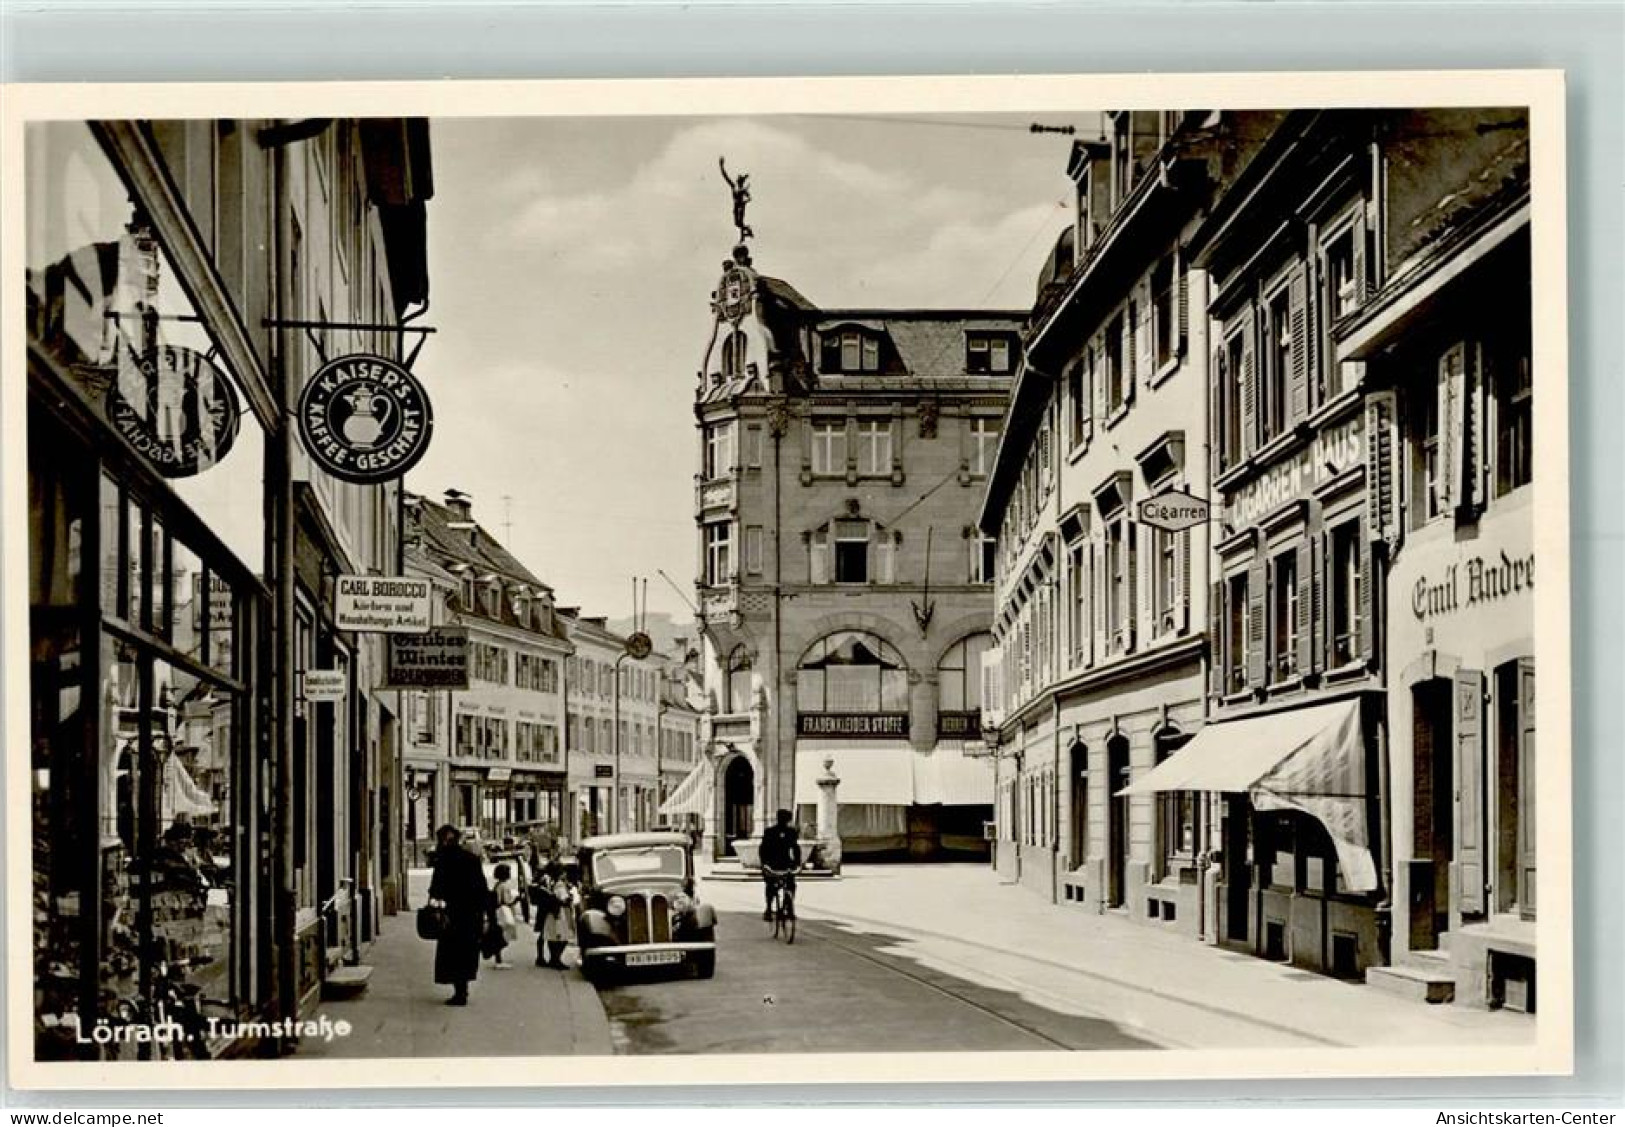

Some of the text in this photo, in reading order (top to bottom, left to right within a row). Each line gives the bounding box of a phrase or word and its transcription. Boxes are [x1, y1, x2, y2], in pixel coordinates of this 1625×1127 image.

[308, 403, 348, 464] KAFFEE
[1143, 502, 1207, 521] Cigarren
[340, 579, 427, 599] CARL BOROCCO
[1411, 562, 1458, 622] Emil
